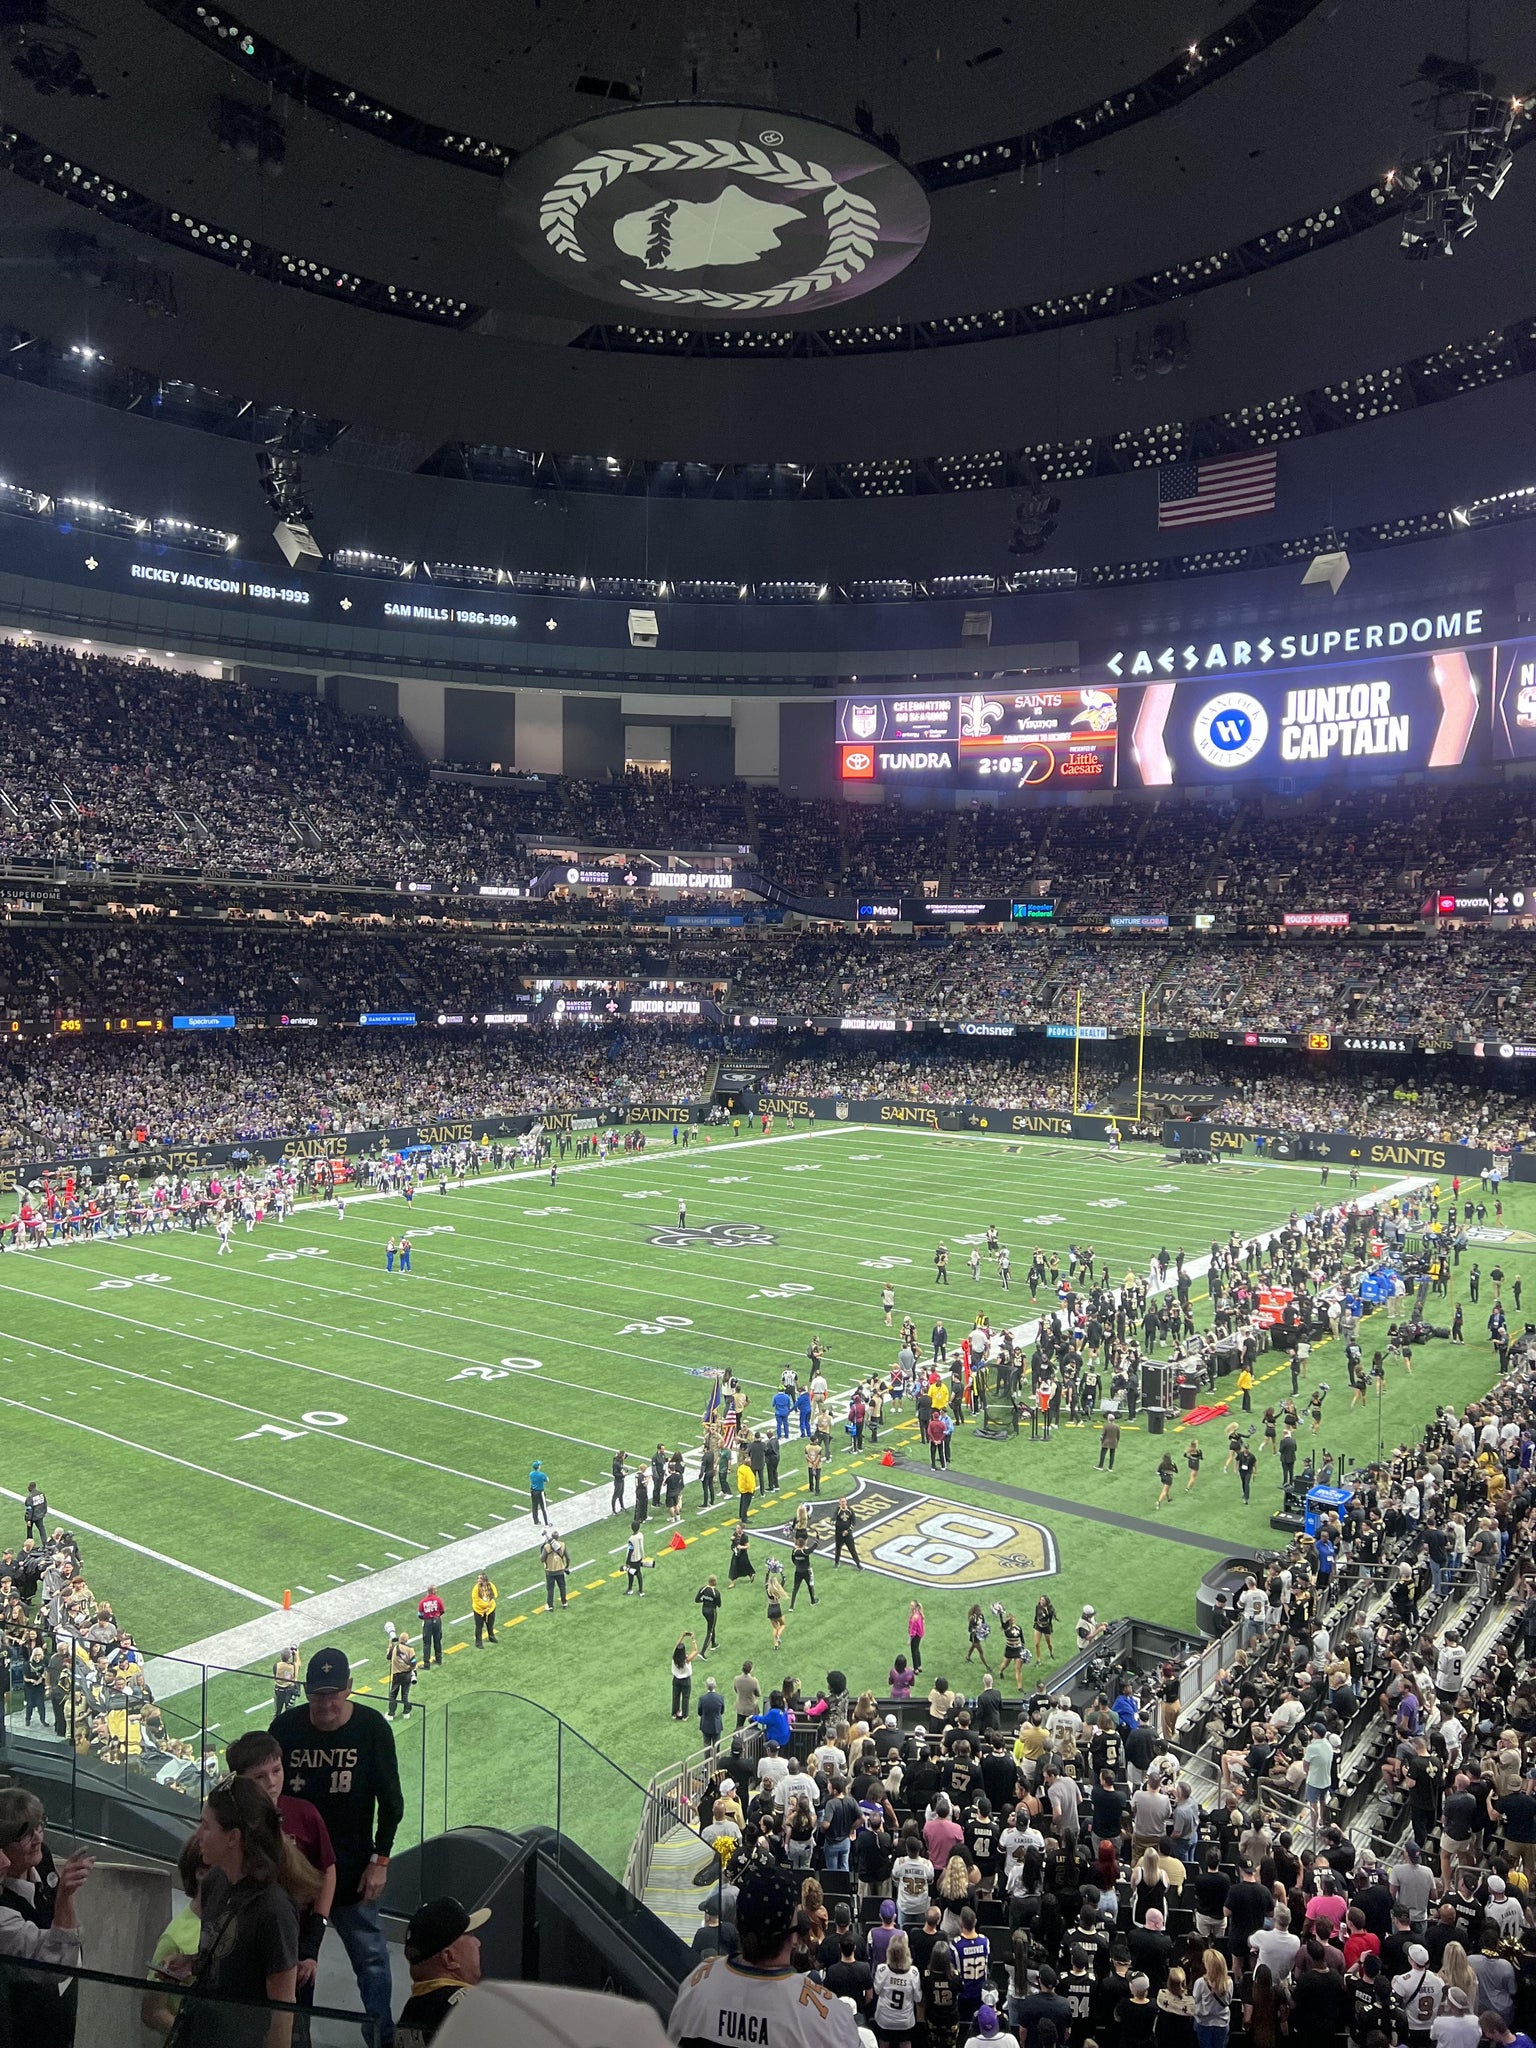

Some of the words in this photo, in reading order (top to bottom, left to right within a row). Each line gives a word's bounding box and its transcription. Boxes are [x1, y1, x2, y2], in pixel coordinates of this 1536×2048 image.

[131, 564, 180, 585] RICKEY
[180, 571, 240, 595] JACKSON
[248, 584, 310, 604] 1981-1993
[384, 602, 412, 618] SAM
[412, 604, 449, 621] MILLS
[456, 609, 518, 628] 1986-1994
[1106, 636, 1275, 677] CAESARS
[1280, 609, 1484, 659] SUPERDOME
[1014, 694, 1062, 709] SAINTS
[1281, 680, 1391, 726] JUNIOR
[1281, 714, 1410, 761] CAPTAIN
[879, 752, 952, 770] TUNDRA
[979, 757, 1023, 774] 2:05
[1069, 753, 1098, 765] Little
[1060, 763, 1103, 775] Caesars
[132, 865, 163, 875] SAINTS
[650, 872, 688, 887] JUNIOR
[688, 873, 733, 888] CAPTAIN
[6, 890, 61, 900] SUPERDOME
[1455, 898, 1489, 908] TOYOTA
[1512, 892, 1525, 908] 0
[872, 905, 899, 915] Meta
[1027, 910, 1053, 918] Federal
[1111, 917, 1141, 925] VENTURE
[1141, 917, 1168, 925] GLOBAL
[1285, 914, 1312, 924] ROUSES
[630, 1000, 664, 1013] JUNIOR
[665, 1001, 700, 1014] CAPTAIN
[60, 1020, 81, 1031] 2:05
[188, 1017, 216, 1025] Spectrum
[290, 1017, 318, 1025] entergy
[841, 1019, 866, 1029] JUNIOR
[866, 1019, 896, 1030] CAPTAIN
[966, 1023, 1014, 1036] Ochsner
[1048, 1026, 1077, 1036] PEOPLES
[1079, 1027, 1106, 1037] HEALTH
[1189, 1030, 1219, 1039] SAINTS
[1259, 1036, 1287, 1045] TOYOTA
[1311, 1035, 1329, 1048] 25
[1344, 1039, 1406, 1051] CAESARS
[1418, 1040, 1453, 1050] SAINTS
[1132, 1090, 1216, 1103] SAINTS
[630, 1106, 690, 1123] SAINTS
[758, 1098, 809, 1115] SAINTS
[881, 1106, 936, 1123] SAINTS
[419, 1124, 473, 1144] SAINTS
[284, 1136, 348, 1159] SAINTS
[1371, 1144, 1446, 1168] SAINTS
[863, 1255, 913, 1269] 50
[100, 1272, 172, 1289] 20
[762, 1282, 815, 1299] 40
[626, 1314, 694, 1336] 30
[462, 1356, 544, 1381] 20
[256, 1410, 349, 1441] 10
[870, 1512, 1019, 1576] 60
[1453, 1659, 1461, 1676] 9
[290, 1748, 358, 1770] SAINTS
[823, 1762, 834, 1777] 9
[329, 1770, 352, 1793] 18
[951, 1772, 971, 1791] 57
[974, 1837, 990, 1857] 41
[902, 1877, 926, 1895] 32
[963, 1956, 986, 1979] 52
[890, 1977, 907, 1987] BREES
[799, 1977, 833, 2020] 75
[890, 1989, 904, 2010] 9
[933, 1989, 953, 2006] 12
[1069, 1996, 1090, 2018] 94
[1418, 1995, 1434, 2021] 9
[718, 2009, 769, 2046] FUAGA
